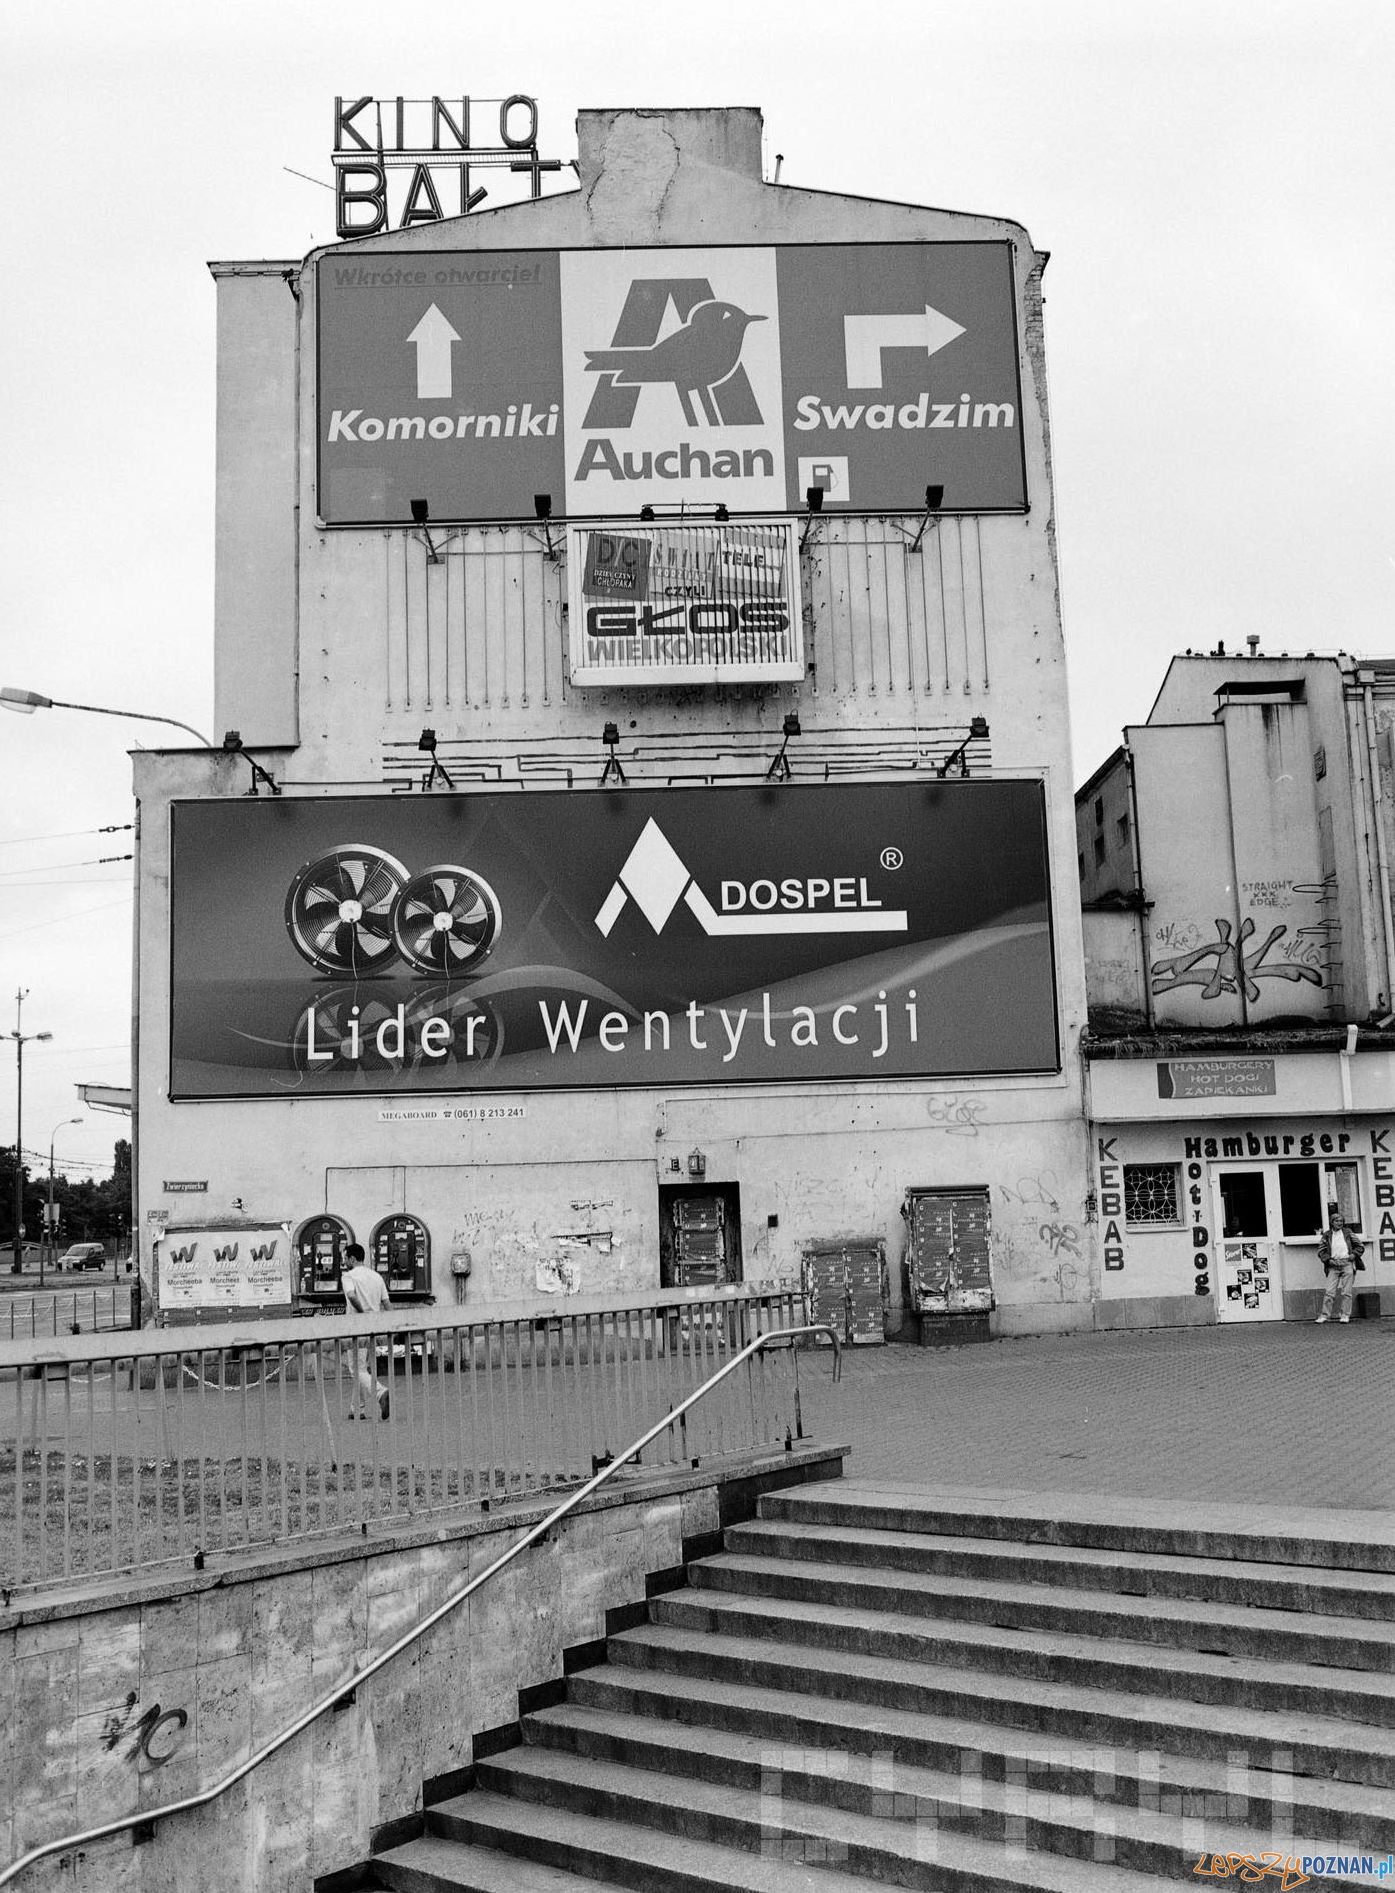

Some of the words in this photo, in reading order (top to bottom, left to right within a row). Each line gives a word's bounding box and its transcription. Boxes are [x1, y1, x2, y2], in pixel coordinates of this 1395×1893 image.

[334, 94, 538, 150] KINO
[336, 160, 582, 239] BAŁT
[334, 267, 428, 286] Wkrótce
[327, 403, 560, 442] Komorniki
[793, 393, 1015, 430] Swadzim
[573, 438, 774, 482] Auchan
[722, 550, 764, 568] TELE
[665, 585, 706, 598] CZYLI
[587, 602, 790, 637] GŁOS
[587, 634, 788, 662] WIELKOPOLSKI
[722, 878, 882, 911] DOSPEL
[1242, 880, 1293, 892] STRAIGHT
[307, 1003, 486, 1060] Lider
[540, 990, 919, 1062] Wentylacji
[1174, 1061, 1273, 1072] HAMBURGERY
[1190, 1075, 1220, 1084] HOT
[1224, 1073, 1259, 1084] DOGI
[1184, 1085, 1268, 1096] ZAPIEKANKI
[382, 1111, 437, 1119] MEGABOARD
[454, 1109, 477, 1119] (061)
[488, 1109, 505, 1118] 213
[507, 1108, 524, 1117] 241
[1184, 1129, 1351, 1159] Hamburger
[1098, 1137, 1125, 1271] KEBAB
[1370, 1129, 1395, 1262] KEBAB
[167, 1278, 203, 1286] Morcheeba
[248, 1276, 283, 1284] Morcheeba
